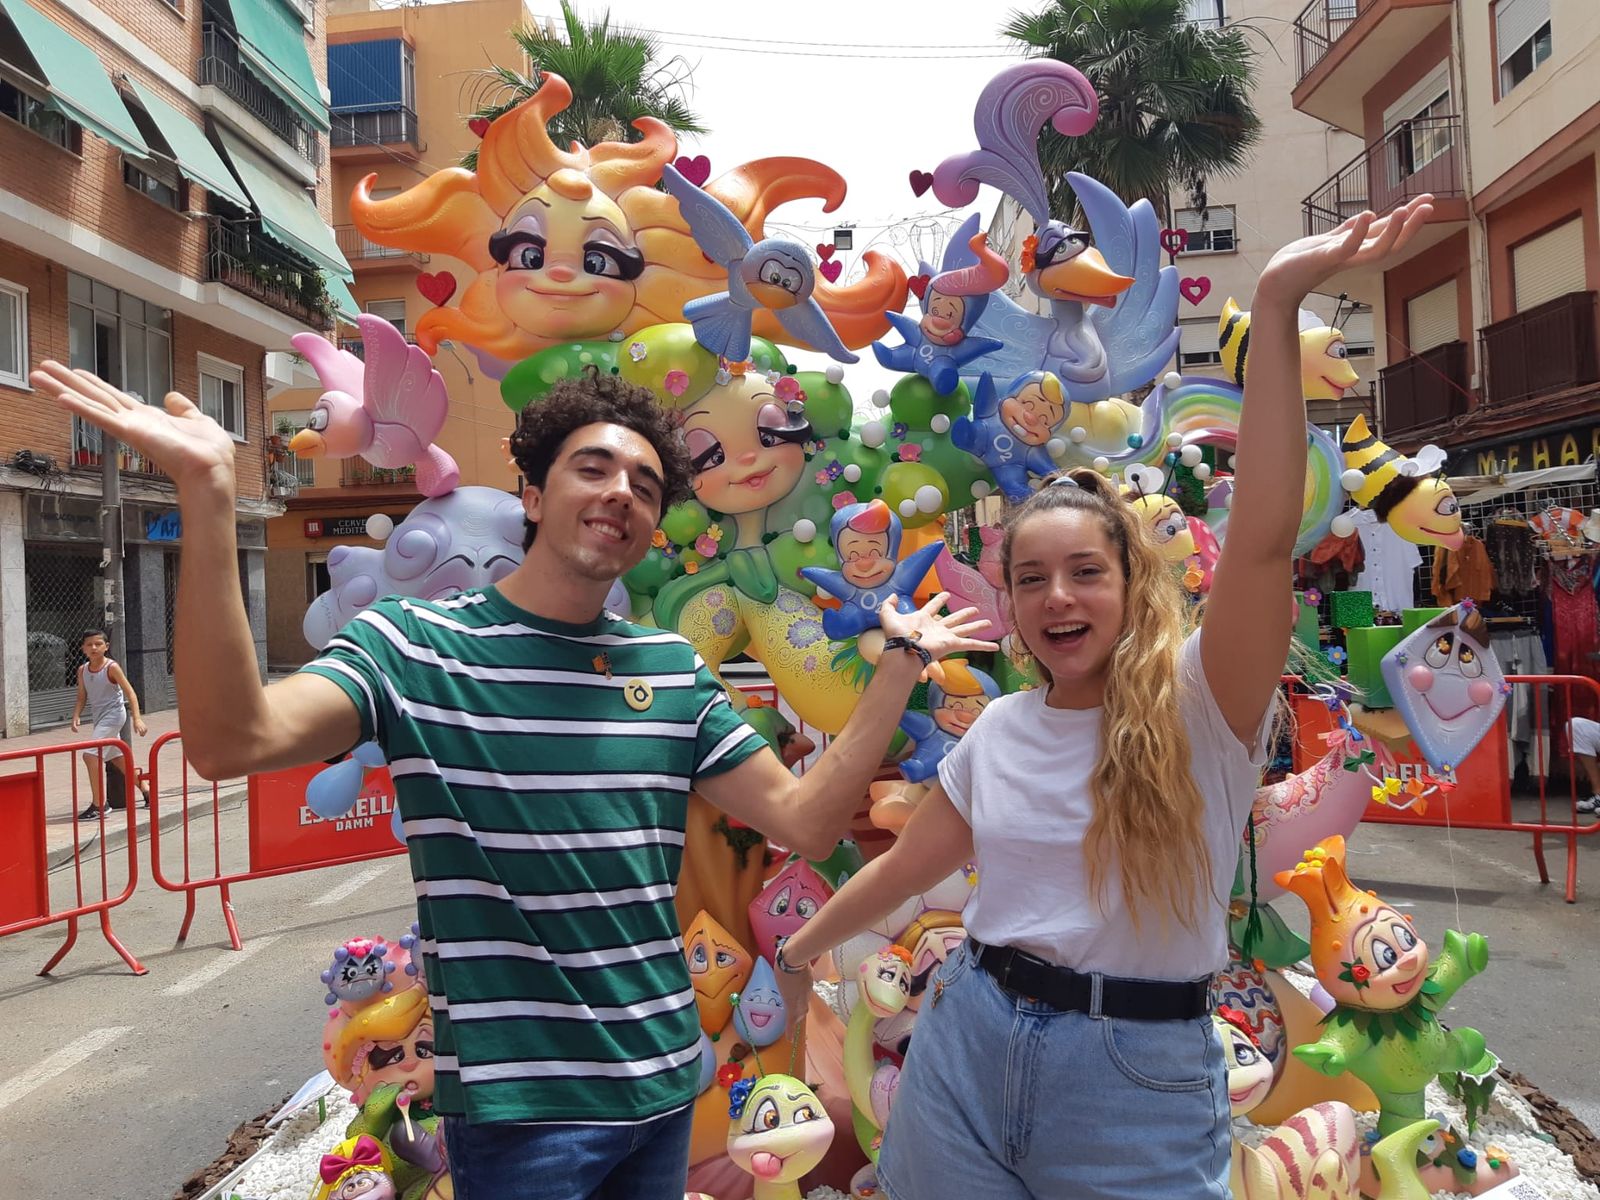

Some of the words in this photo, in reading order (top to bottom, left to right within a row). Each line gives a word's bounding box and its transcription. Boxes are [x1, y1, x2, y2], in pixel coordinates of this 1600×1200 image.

[993, 434, 1014, 462] O2
[299, 794, 399, 825] EELL
[335, 817, 374, 832] DAMM
